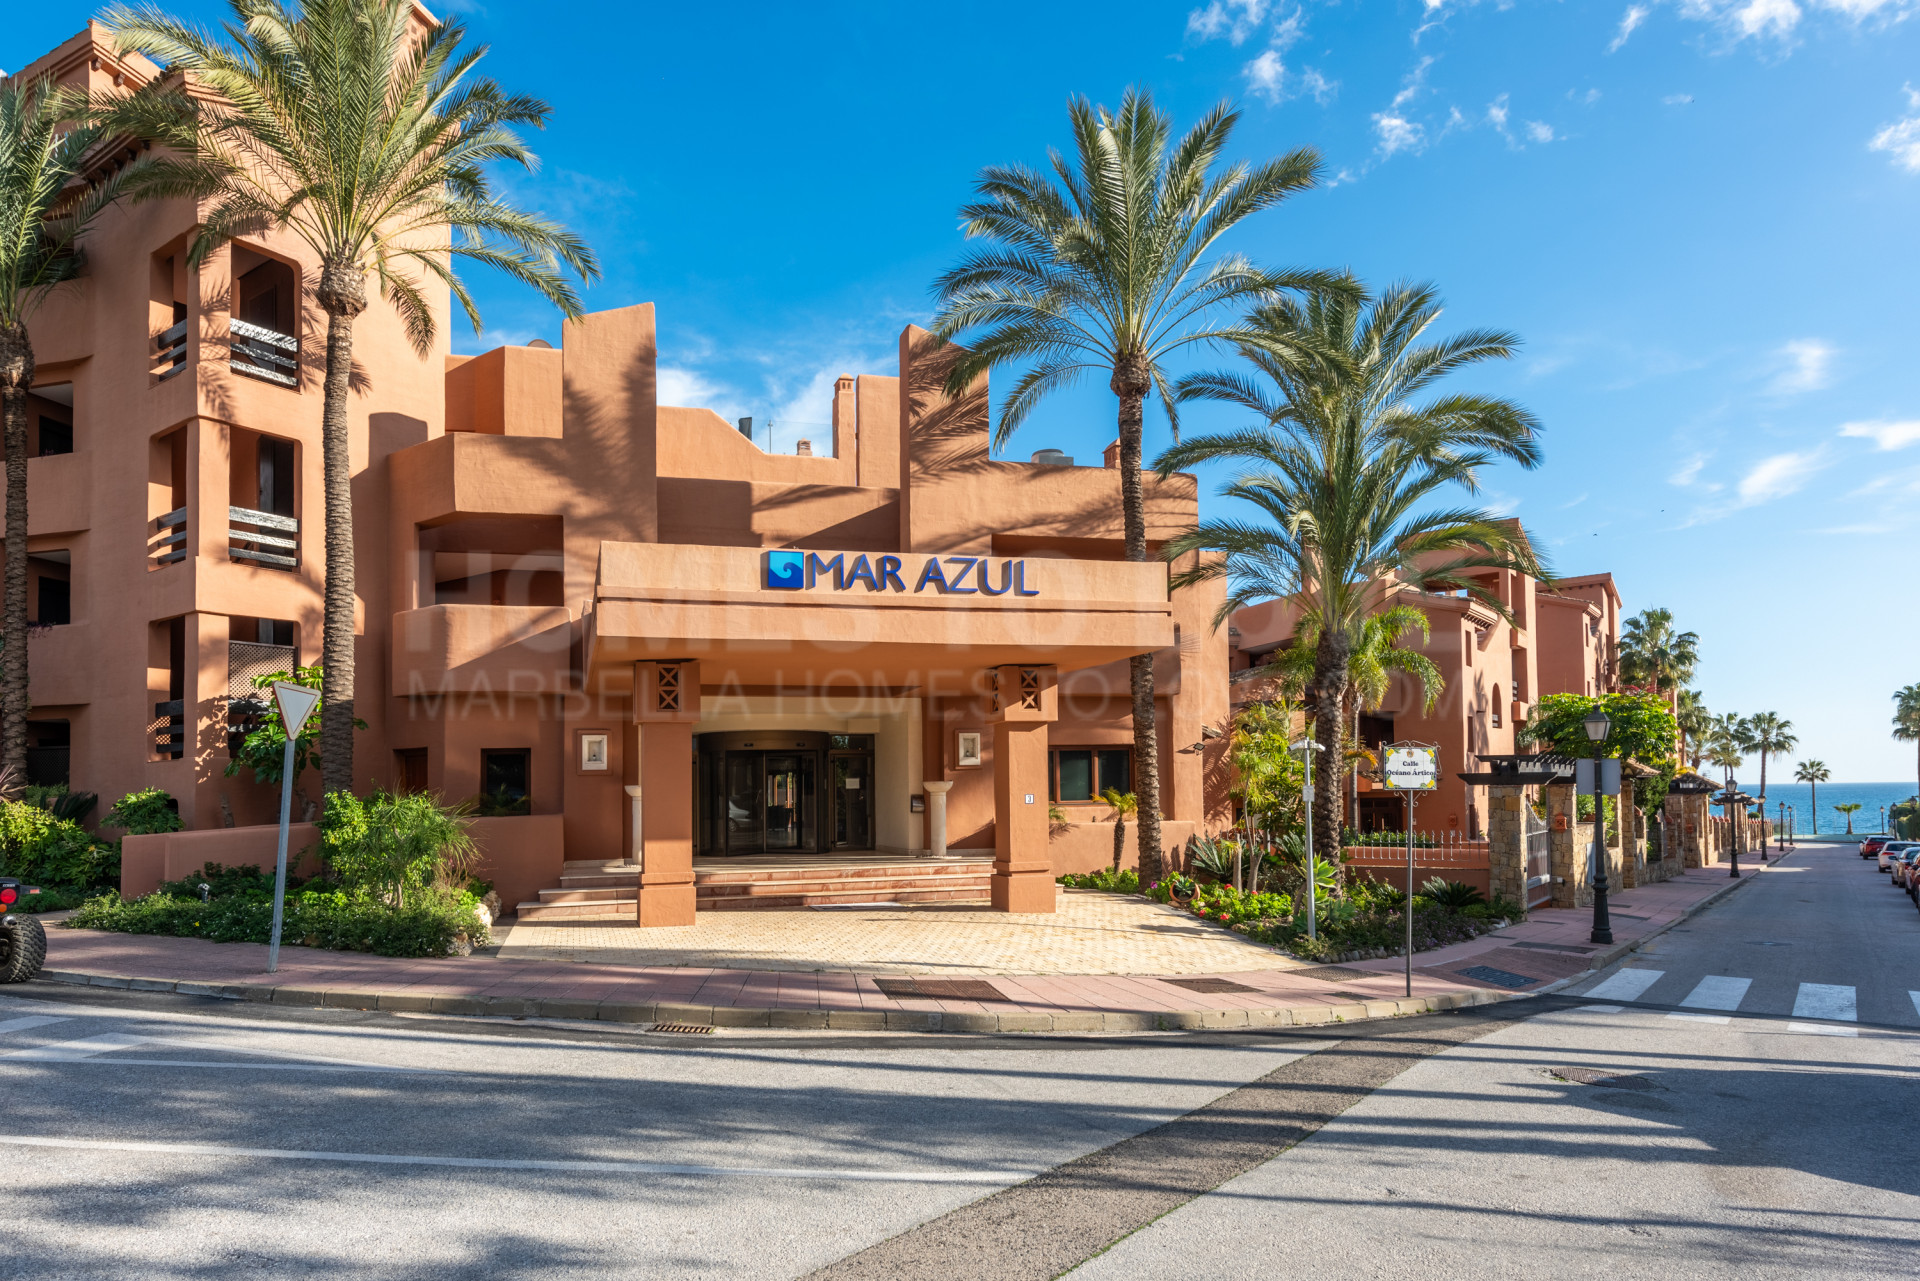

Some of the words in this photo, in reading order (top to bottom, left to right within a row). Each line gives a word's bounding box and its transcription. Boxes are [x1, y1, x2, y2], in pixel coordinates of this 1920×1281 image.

[811, 551, 906, 591] MAR
[919, 556, 1040, 595] AZUL
[1386, 768, 1411, 776] Océano
[1412, 768, 1434, 776] Ártico
